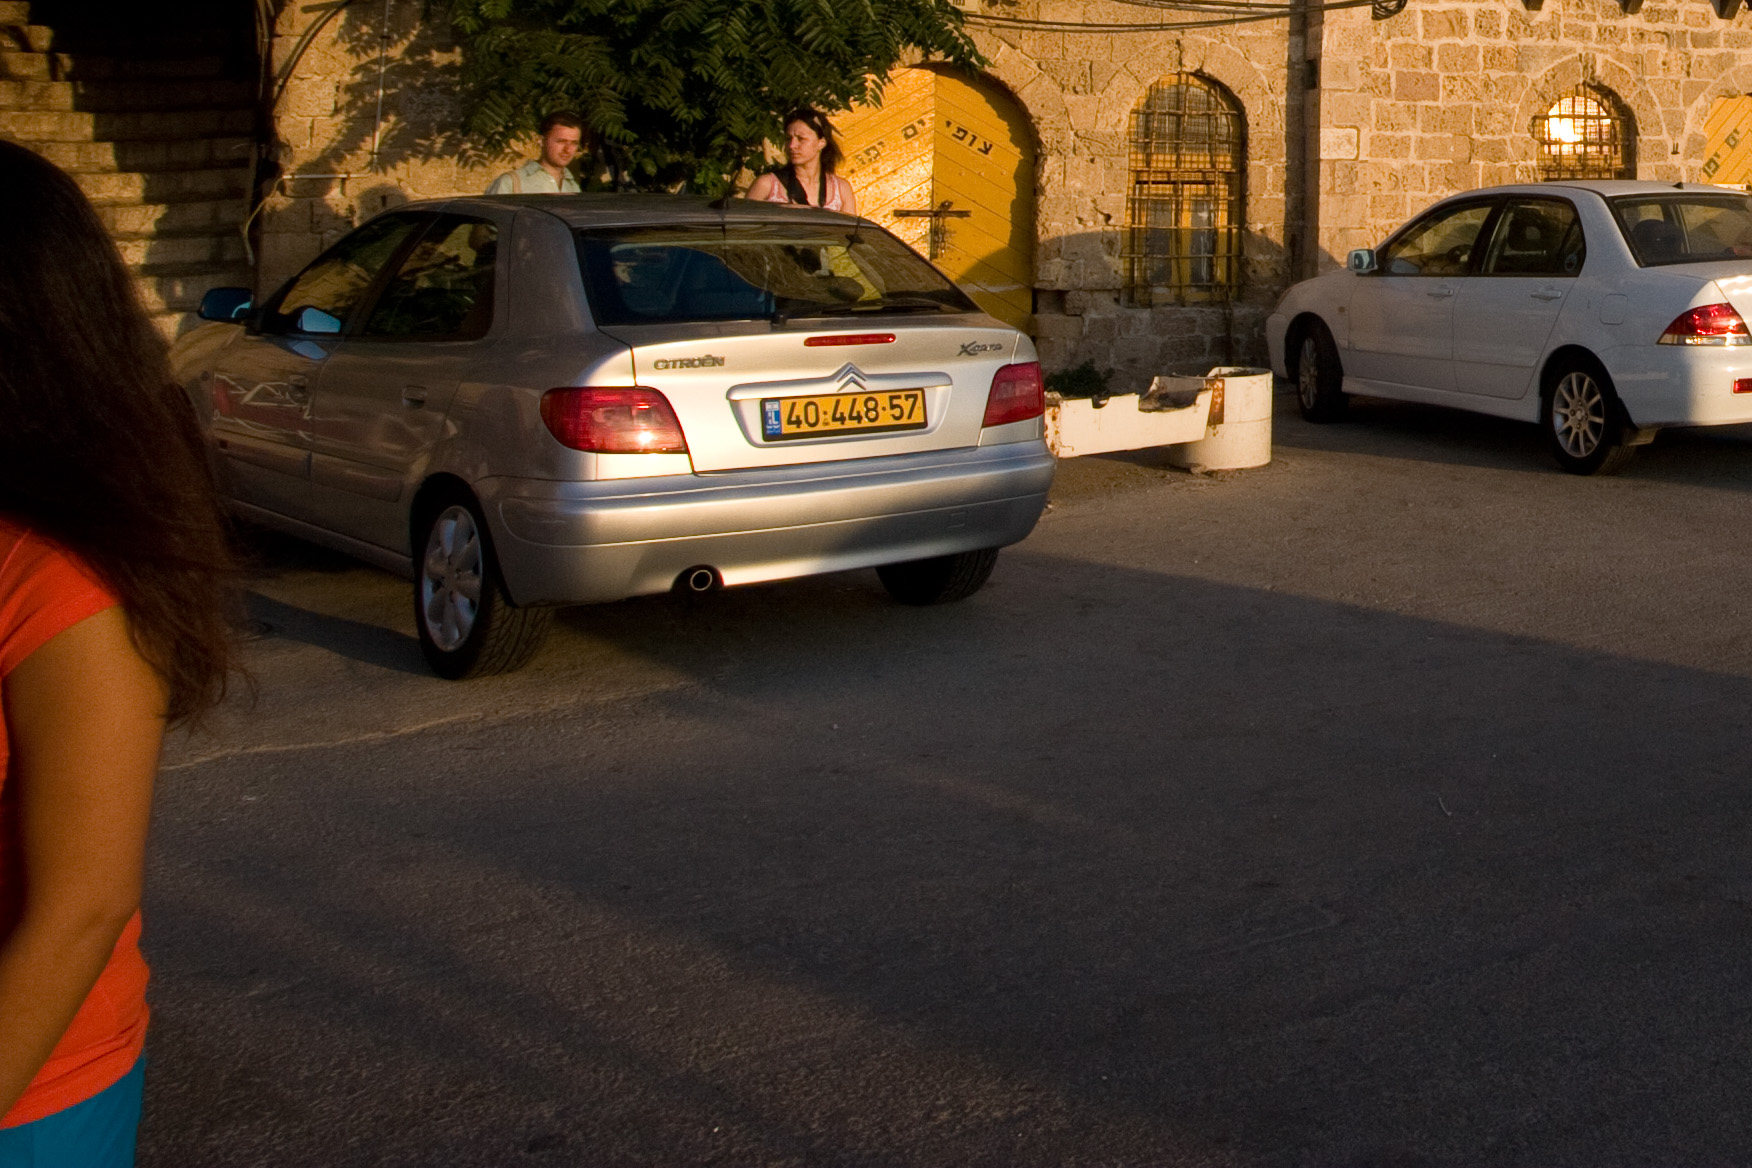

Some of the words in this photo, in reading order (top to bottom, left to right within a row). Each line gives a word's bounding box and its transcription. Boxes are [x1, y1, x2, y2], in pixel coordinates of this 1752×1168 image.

[901, 118, 926, 141] ים
[945, 120, 993, 155] צופי
[1724, 128, 1740, 151] ים
[1702, 151, 1721, 179] יפו
